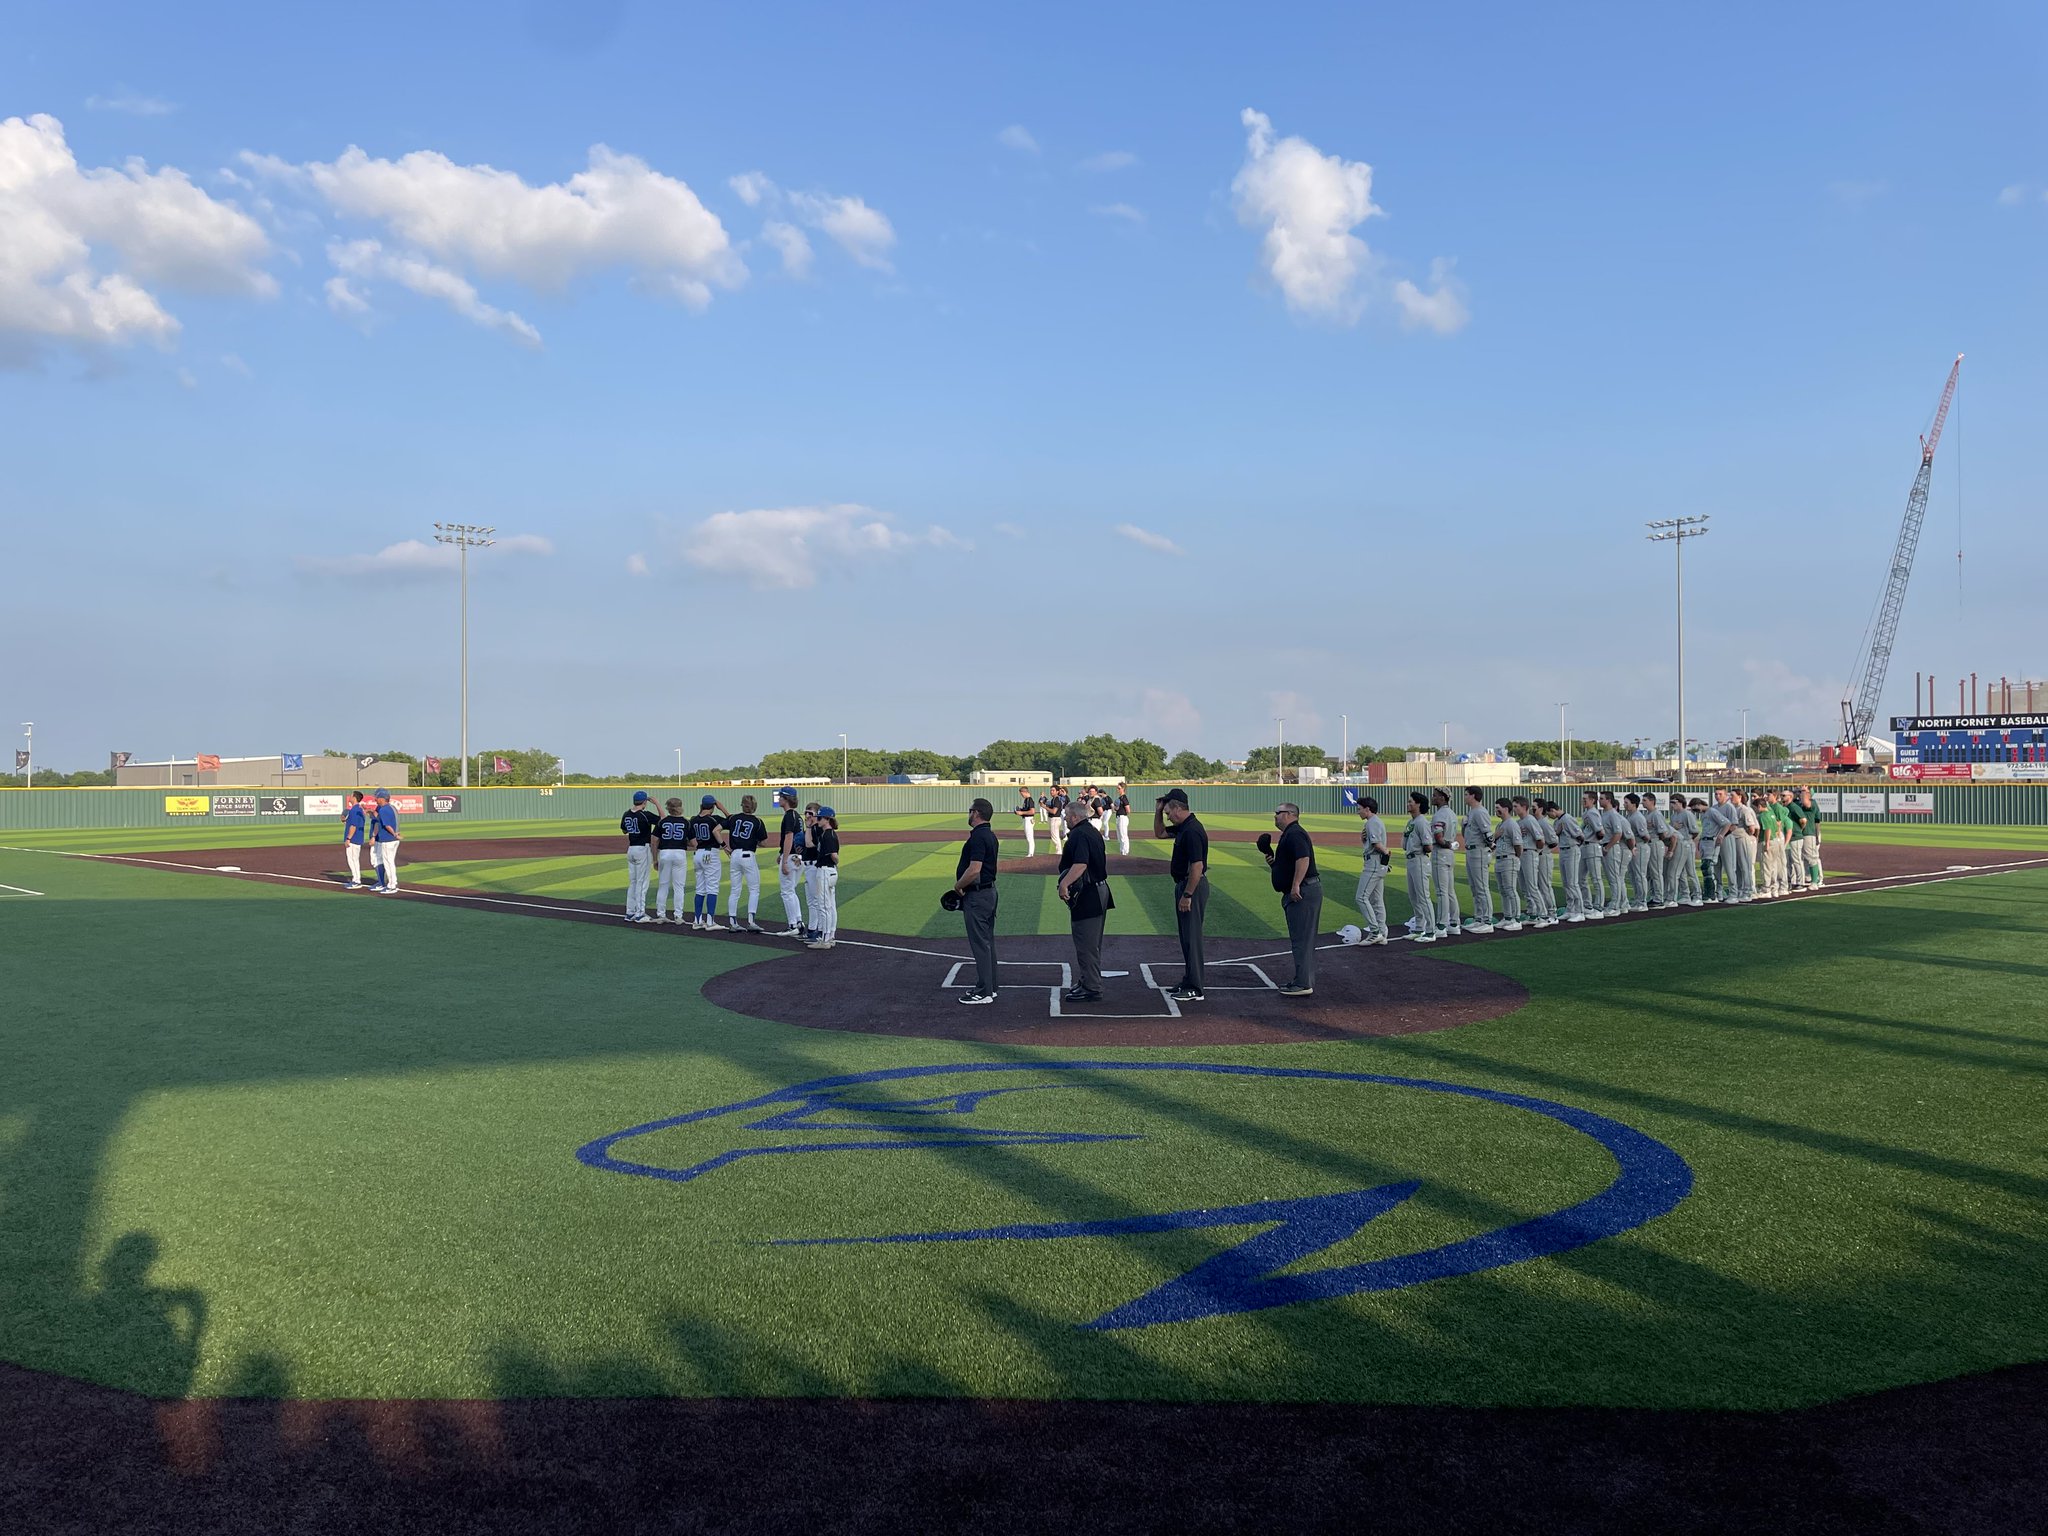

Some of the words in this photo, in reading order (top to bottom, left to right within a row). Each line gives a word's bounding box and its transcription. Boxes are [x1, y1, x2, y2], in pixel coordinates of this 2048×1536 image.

[1917, 719, 1952, 728] NORTH
[1955, 717, 1996, 727] FORNEY
[540, 788, 553, 796] 358
[624, 817, 640, 834] 21
[661, 822, 685, 840] 35
[693, 823, 711, 840] 10
[732, 819, 753, 839] 13
